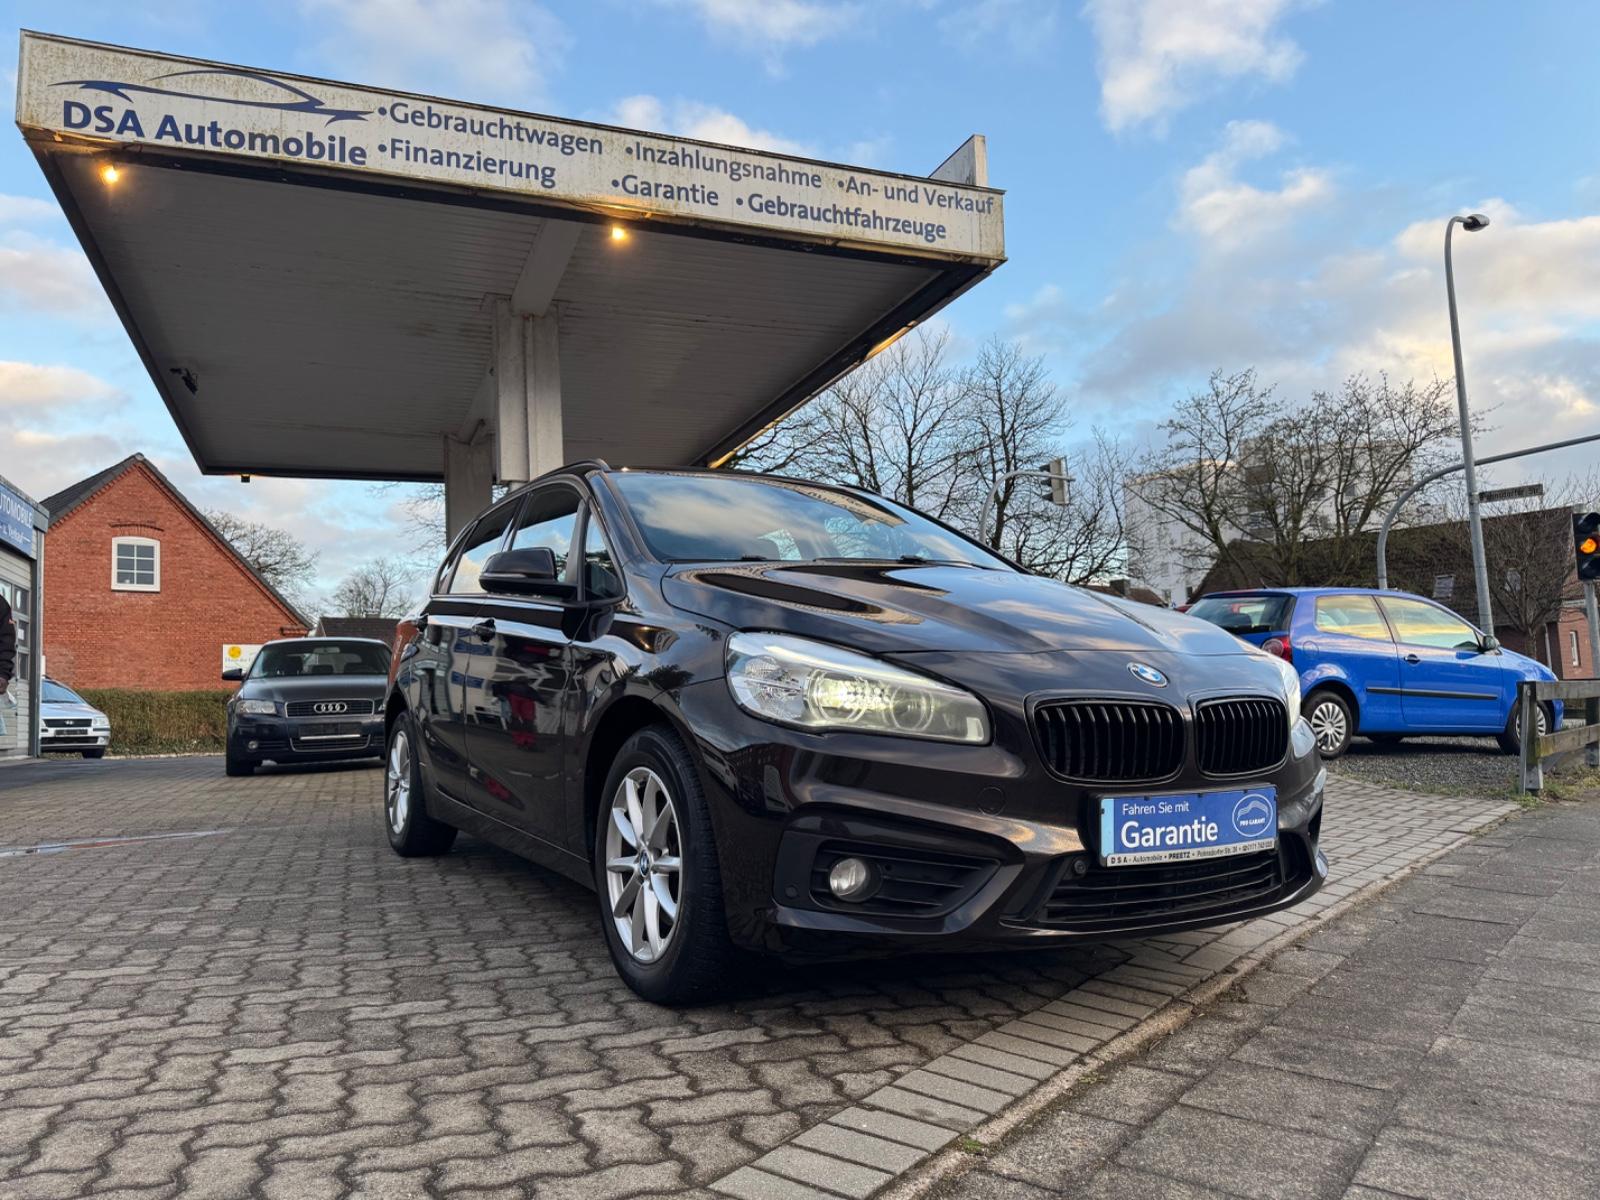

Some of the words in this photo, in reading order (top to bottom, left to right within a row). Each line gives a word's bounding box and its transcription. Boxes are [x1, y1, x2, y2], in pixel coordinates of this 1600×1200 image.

[64, 100, 145, 138] DSA
[155, 114, 367, 166] Automobile
[390, 101, 602, 156] Gebrauchtwagen
[390, 138, 556, 188] Finanzierung
[635, 142, 822, 188] Inzahlungsnahme
[621, 174, 719, 206] Garantie
[845, 177, 879, 197] An-
[884, 183, 919, 204] und
[924, 187, 994, 214] Verkauf
[748, 193, 947, 241] Gebrauchtfahrzeuge
[1122, 802, 1156, 816] Fahren
[1158, 801, 1173, 814] Sie
[1174, 801, 1190, 813] mit
[1121, 816, 1219, 848] Garantie
[1168, 851, 1191, 860] PREETZ
